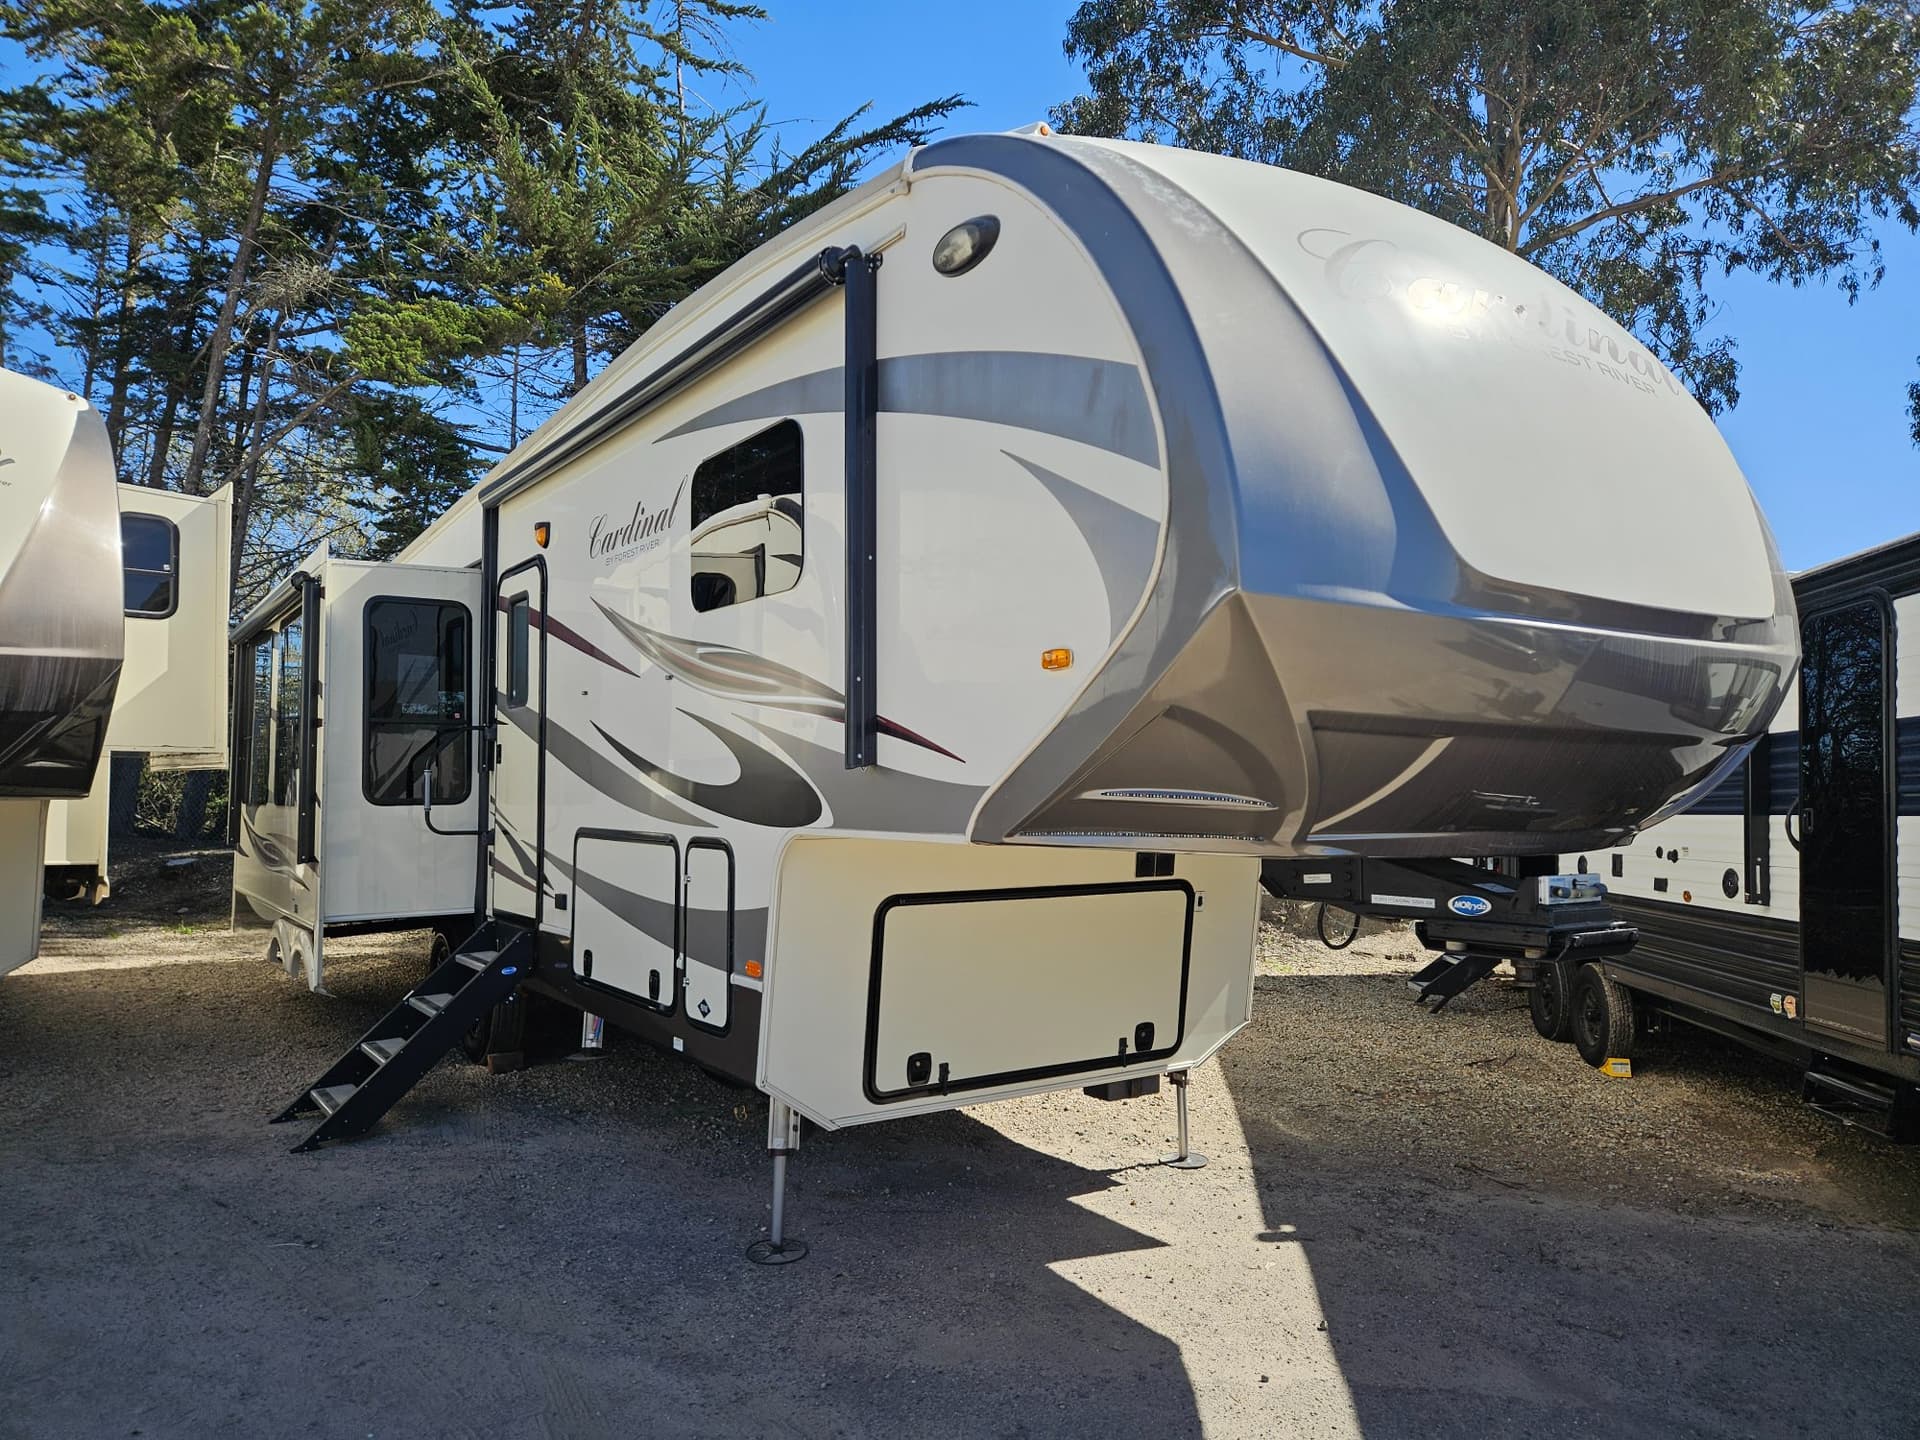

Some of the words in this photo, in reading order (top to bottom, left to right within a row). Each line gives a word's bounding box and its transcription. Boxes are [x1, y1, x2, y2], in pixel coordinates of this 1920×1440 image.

[1596, 361, 1657, 396] RIVER
[589, 474, 688, 559] Cardinal
[614, 546, 640, 562] FOREST
[639, 538, 660, 553] RIVER
